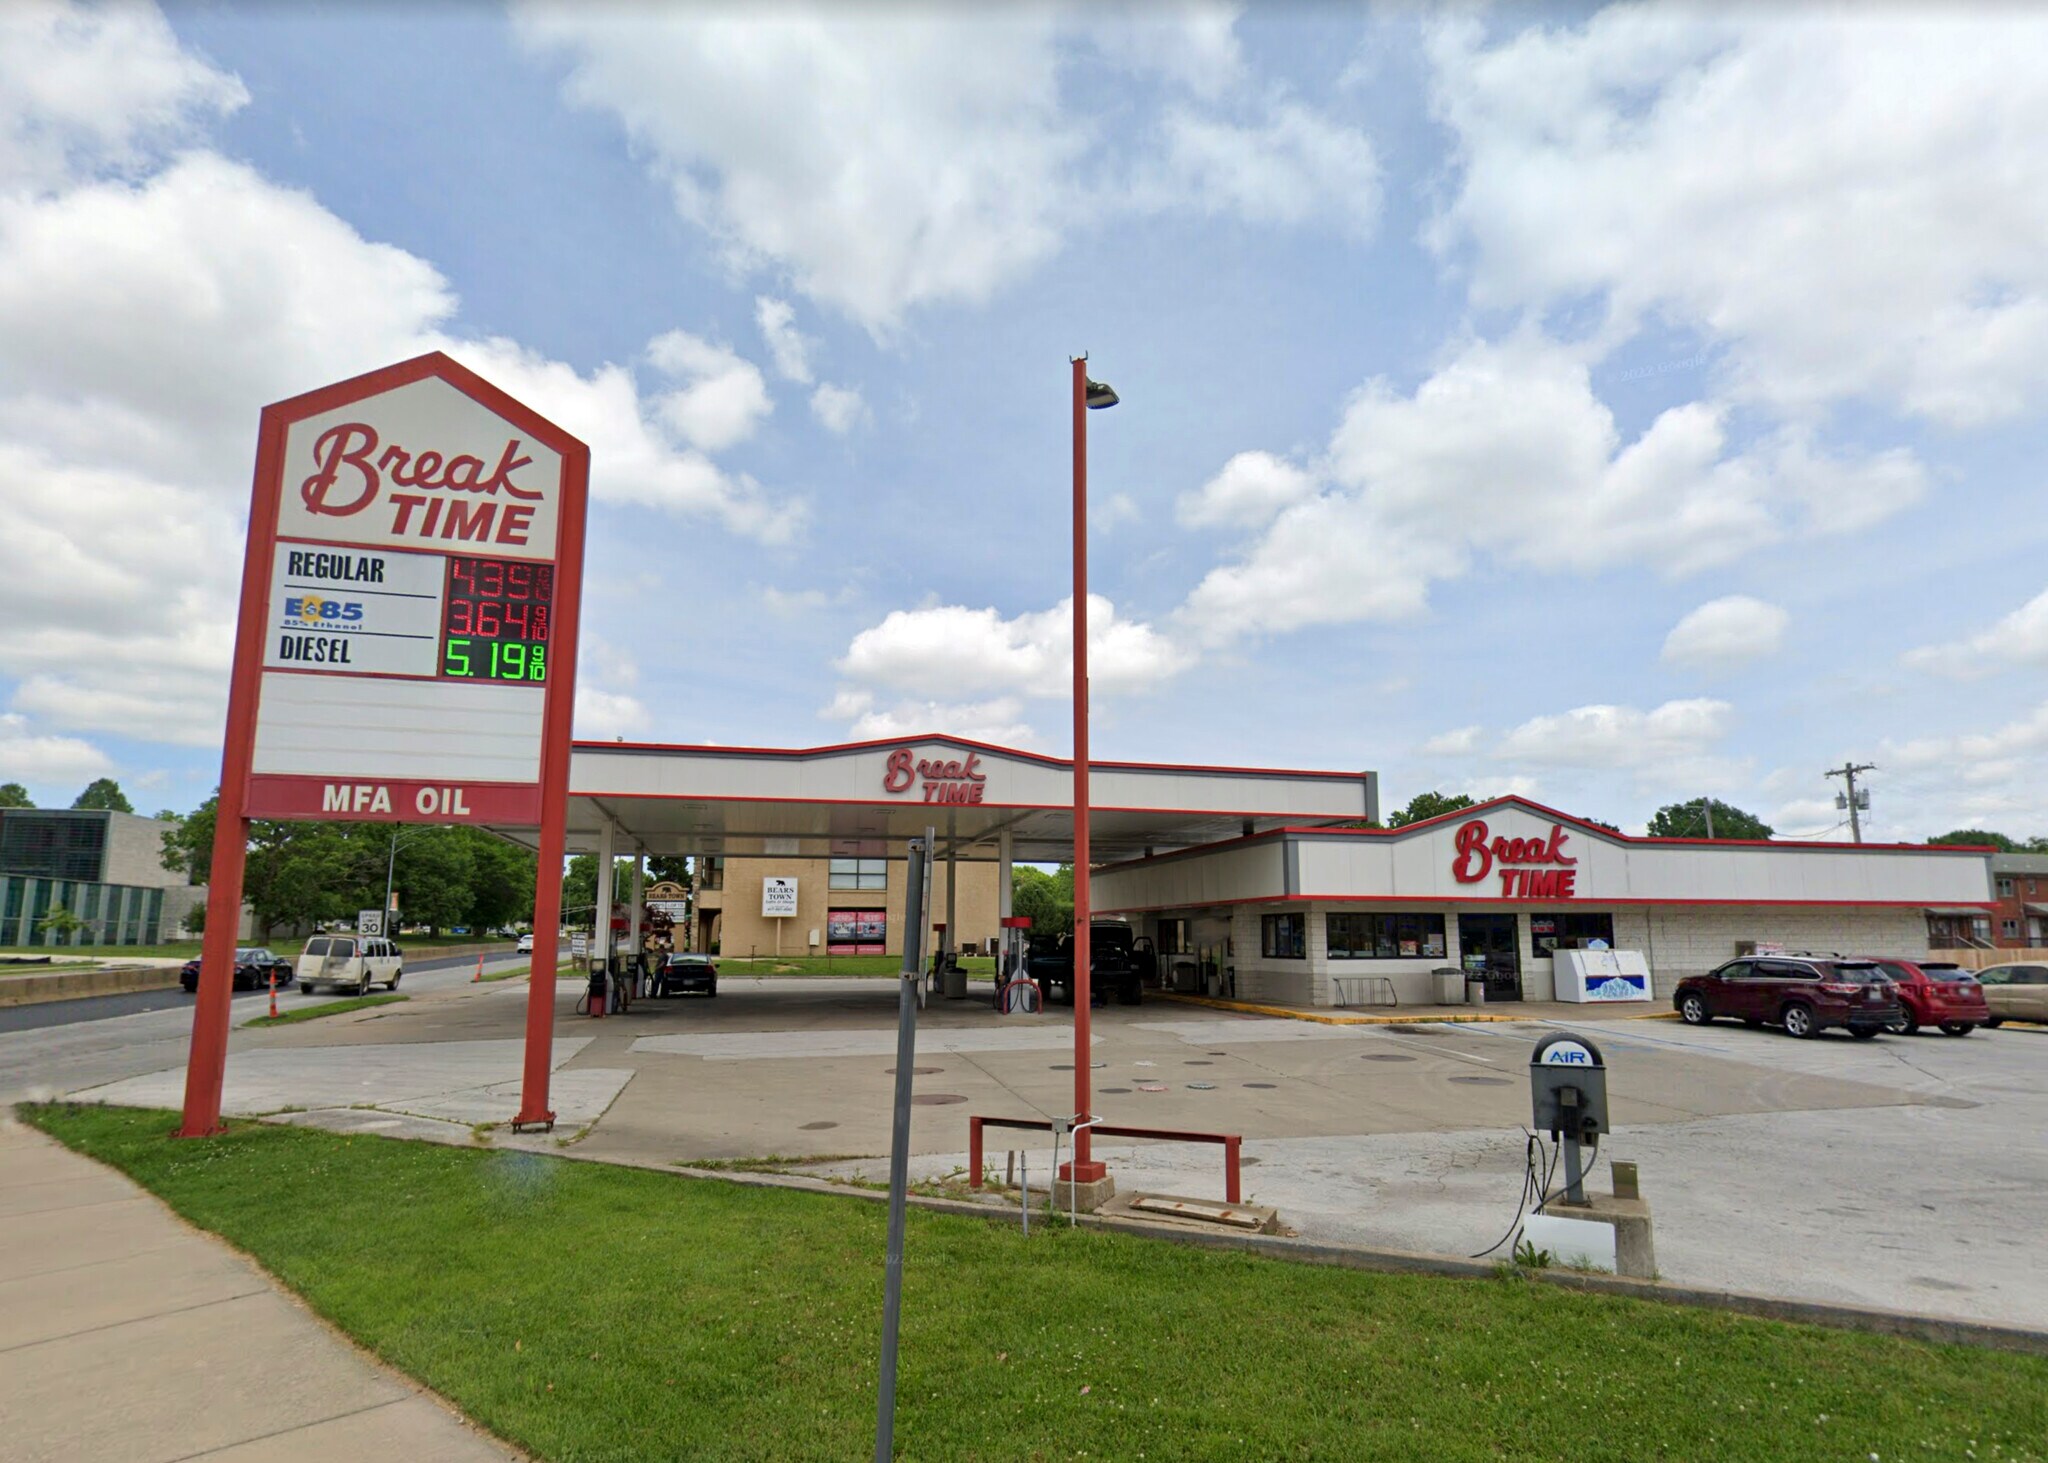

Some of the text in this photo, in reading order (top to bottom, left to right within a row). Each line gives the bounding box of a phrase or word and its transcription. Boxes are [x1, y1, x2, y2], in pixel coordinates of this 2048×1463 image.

[301, 422, 544, 517] Break
[388, 493, 536, 546] TIME
[288, 550, 385, 583] REGULAR
[312, 621, 363, 631] Ethanol
[449, 599, 529, 640] 3.64
[280, 635, 351, 664] DIESEL
[445, 639, 526, 679] 5.19
[883, 748, 986, 793] Break
[322, 784, 471, 815] MFA OIL
[922, 782, 985, 803] TIME
[1452, 820, 1578, 884] Break
[1498, 869, 1577, 898] TIME
[362, 923, 379, 933] 30
[1549, 1051, 1586, 1064] AIR
